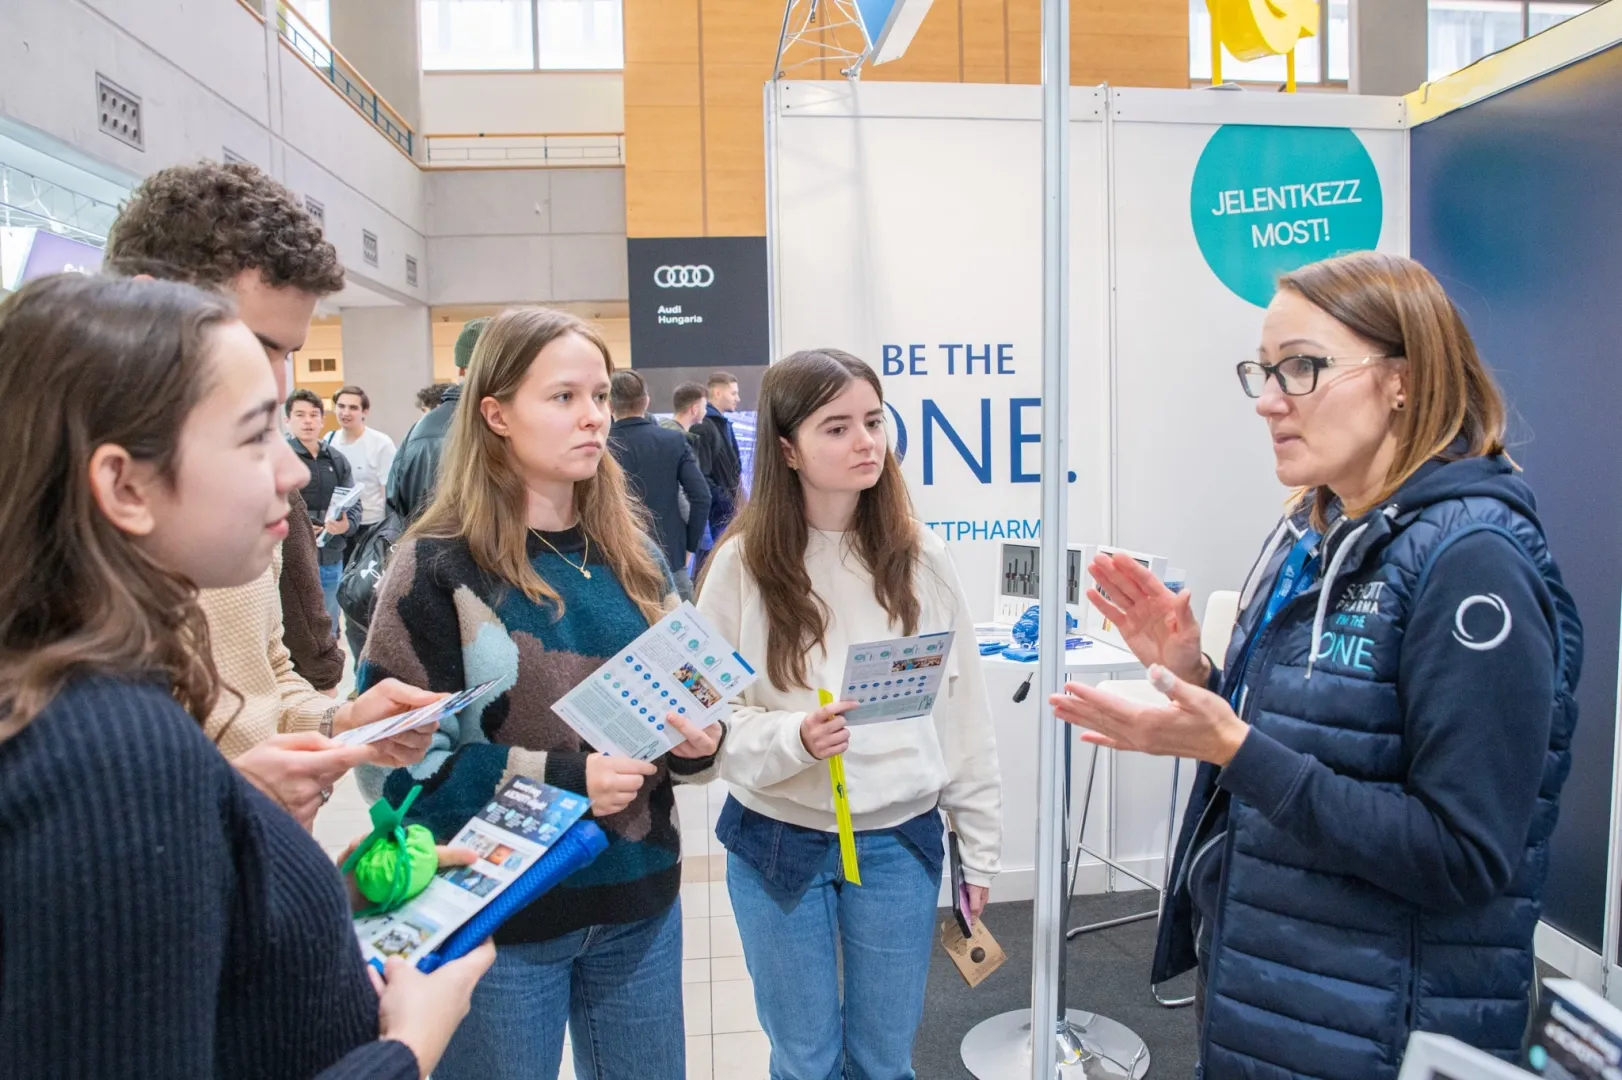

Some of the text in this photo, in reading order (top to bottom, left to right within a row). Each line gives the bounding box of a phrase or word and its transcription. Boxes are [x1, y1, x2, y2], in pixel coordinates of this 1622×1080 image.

[1211, 179, 1363, 216] JELENTKEZZ
[1251, 217, 1331, 248] MOST!
[657, 305, 682, 314] Audi
[657, 314, 703, 325] Hungaria
[882, 343, 1016, 376] BE THE
[925, 519, 1042, 542] TTPHARM
[1316, 631, 1375, 671] ONE
